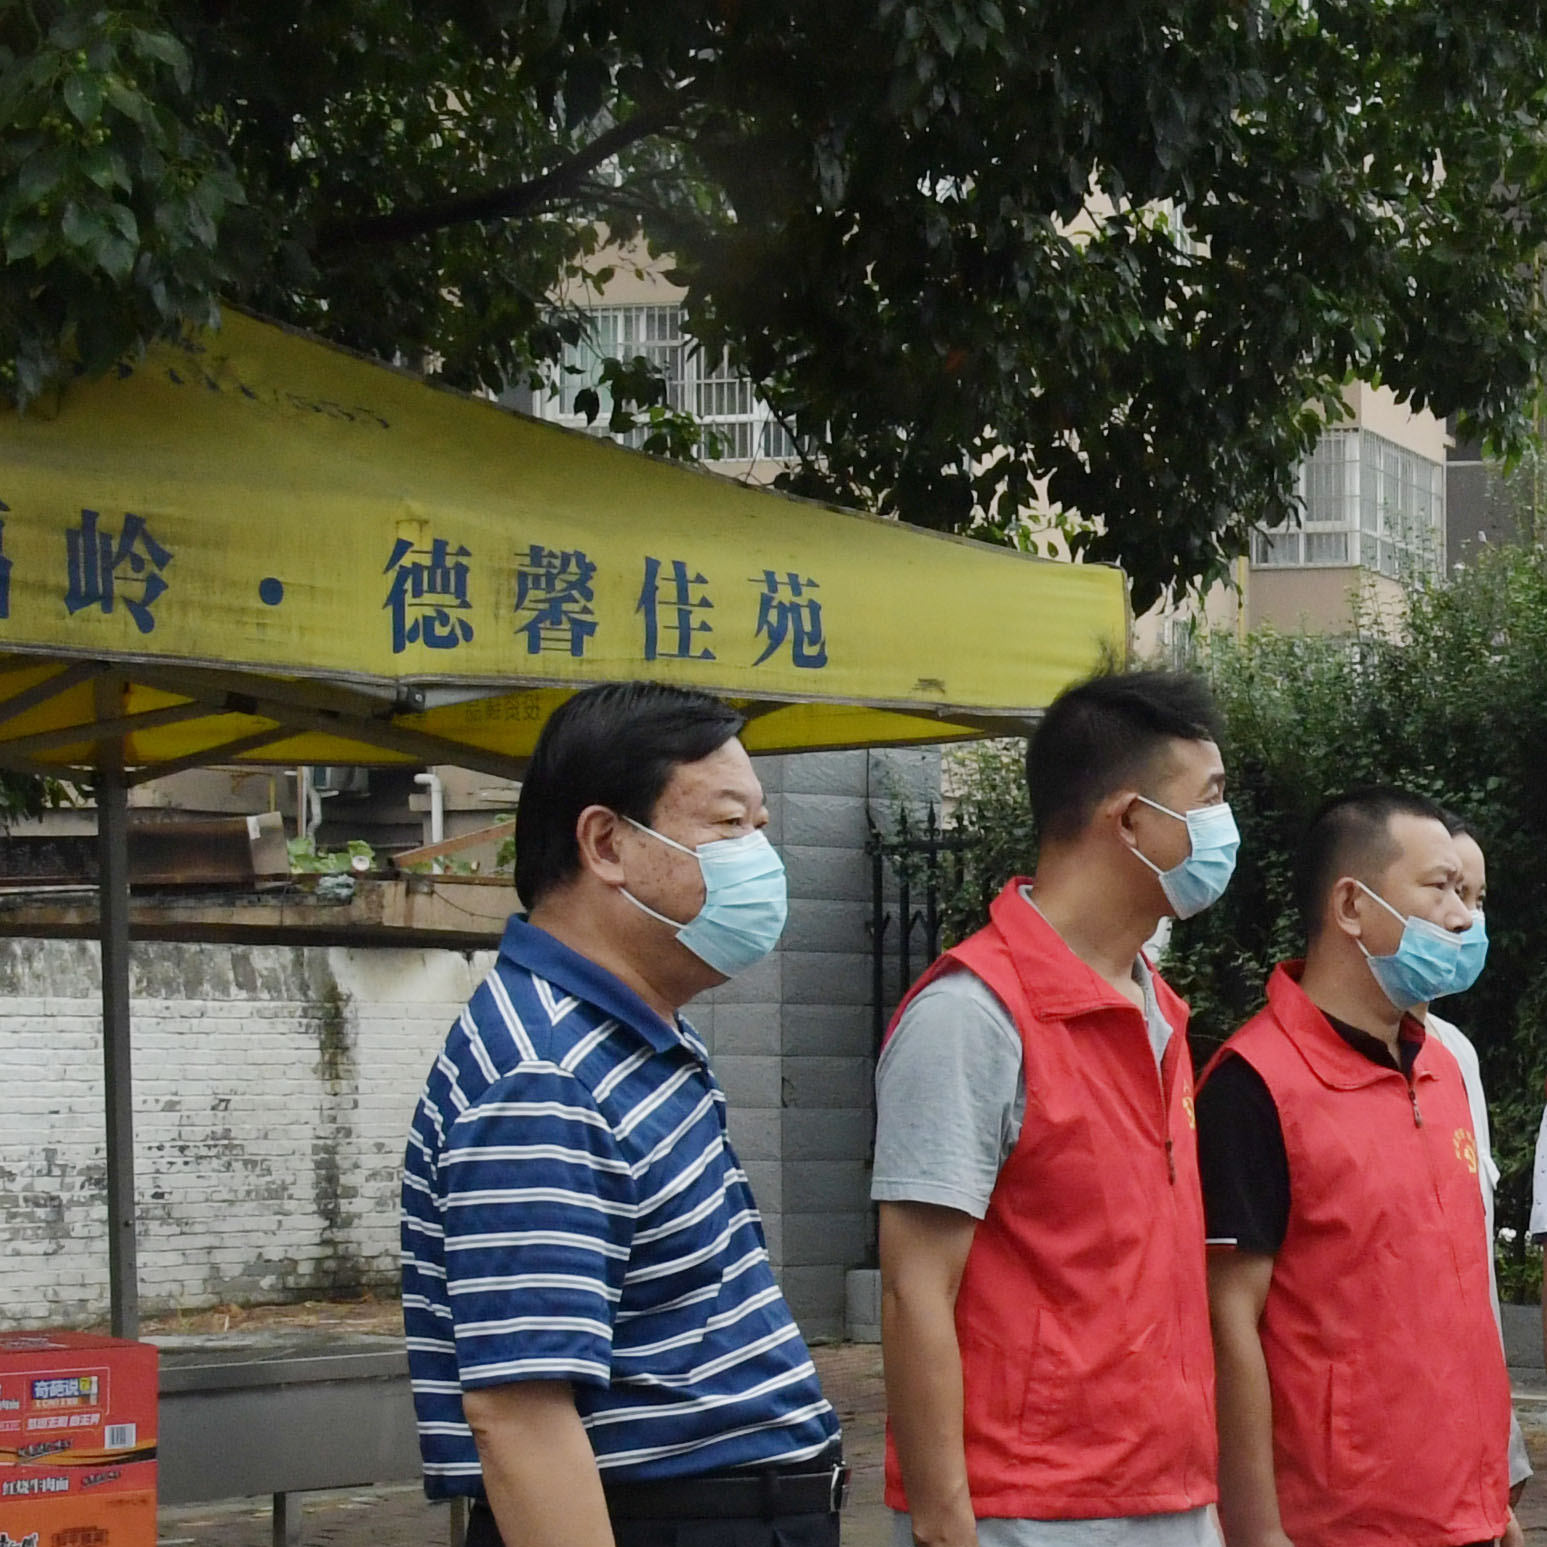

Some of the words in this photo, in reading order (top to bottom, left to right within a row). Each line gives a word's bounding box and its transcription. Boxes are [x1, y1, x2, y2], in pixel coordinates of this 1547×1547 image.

[0, 500, 829, 670] 岭·德馨佳苑
